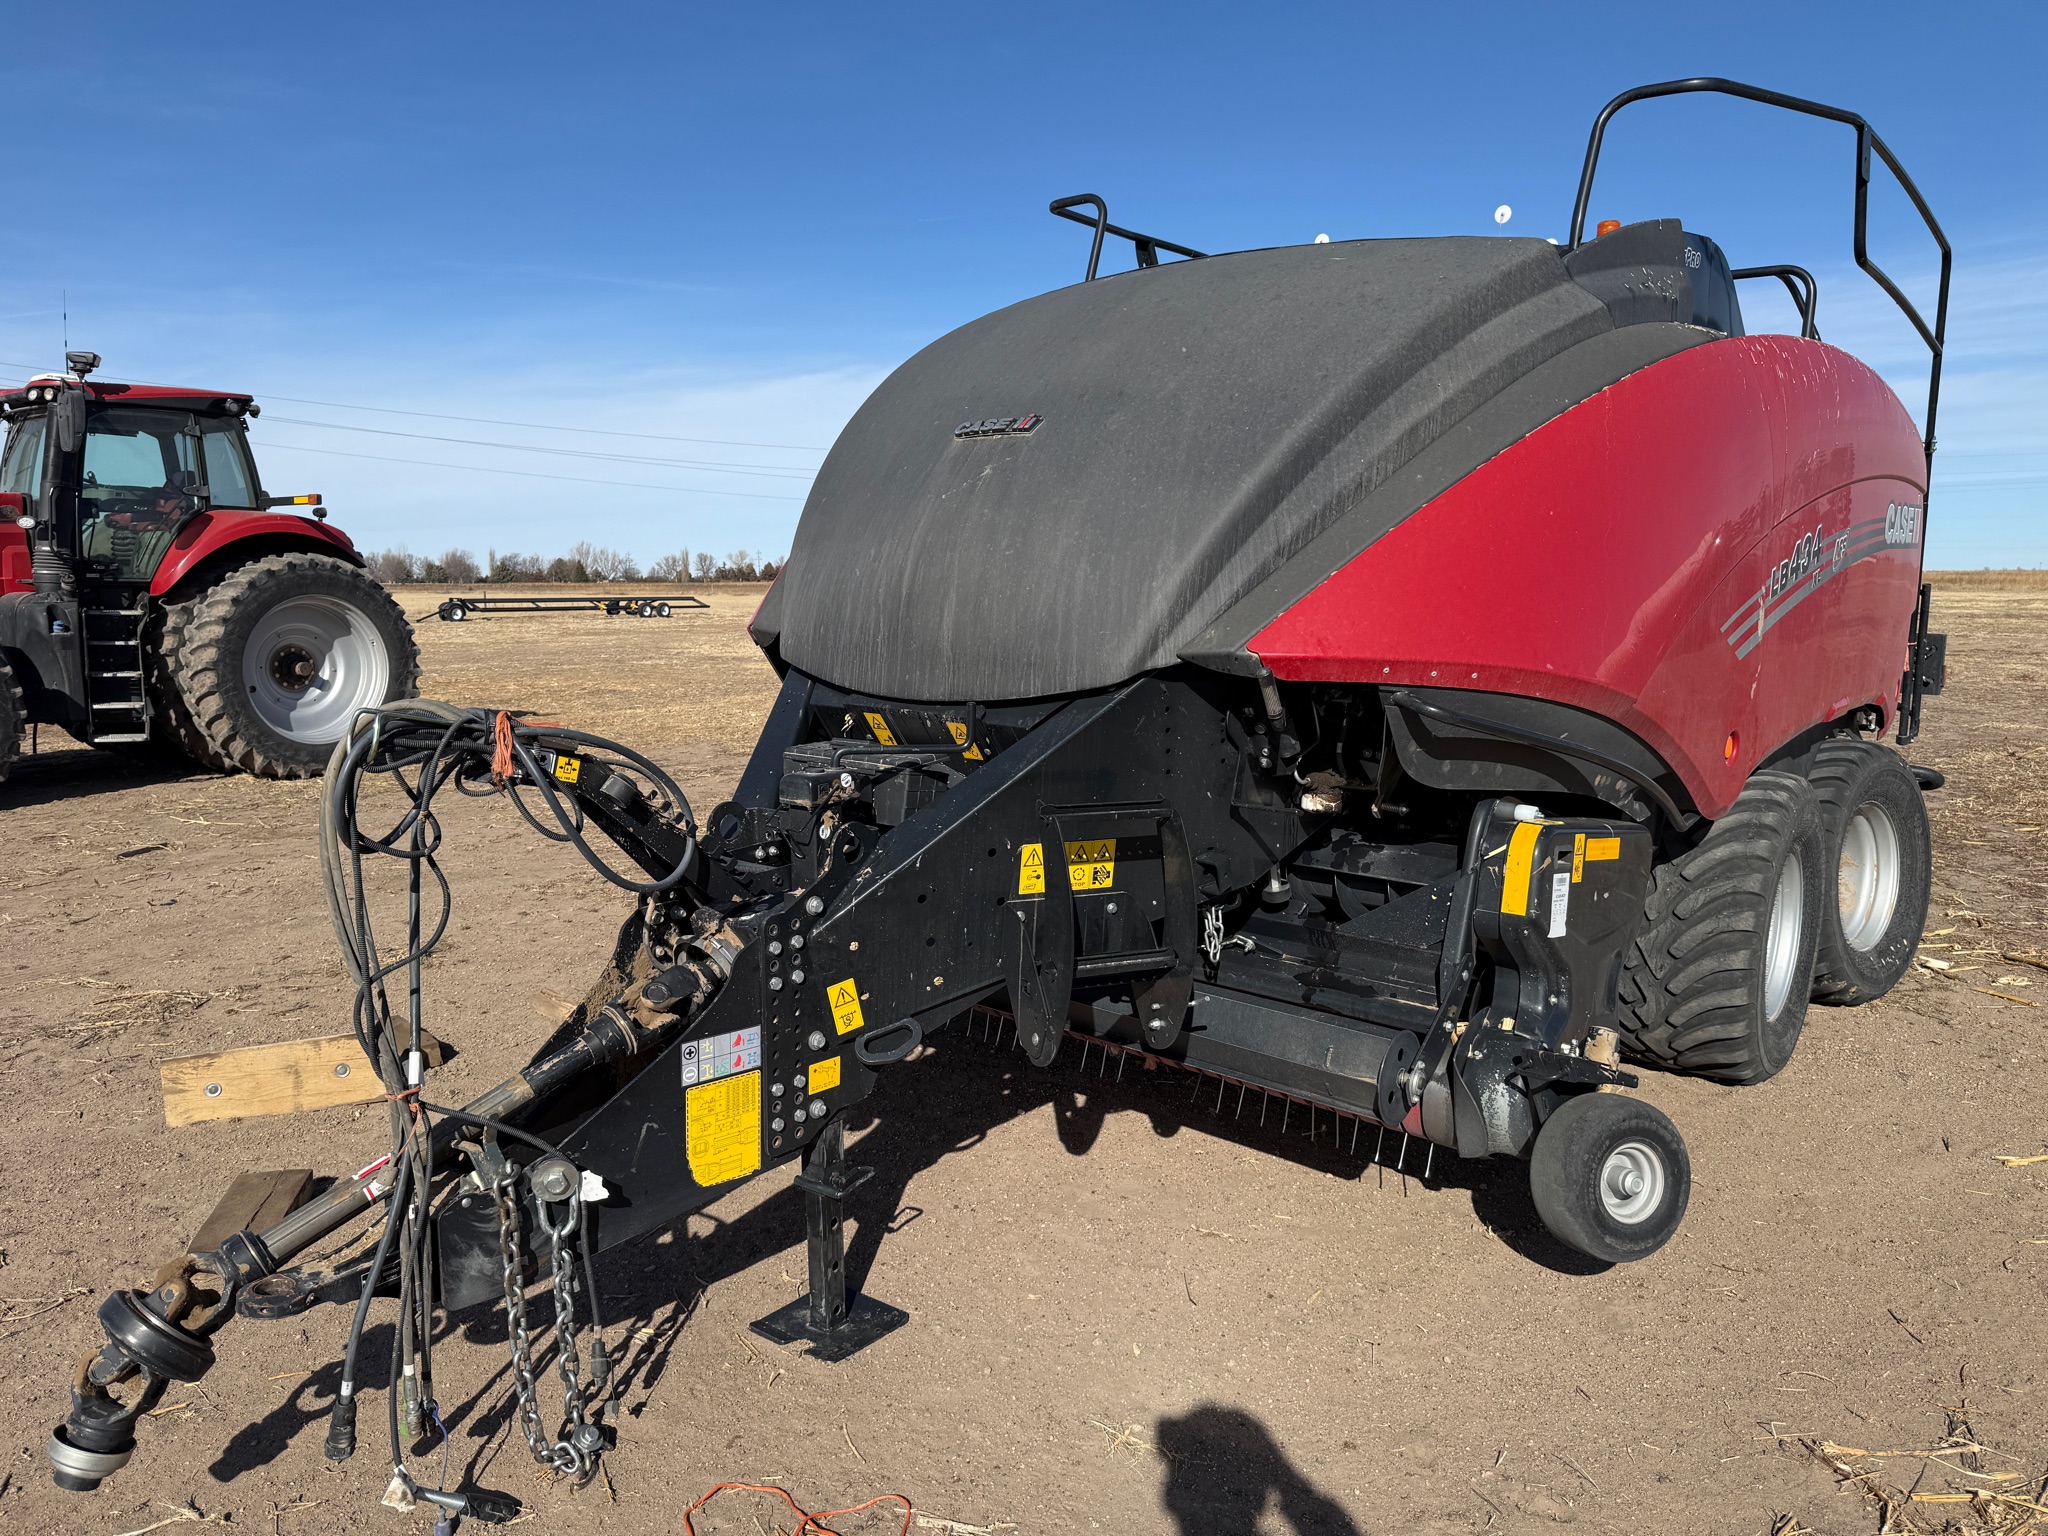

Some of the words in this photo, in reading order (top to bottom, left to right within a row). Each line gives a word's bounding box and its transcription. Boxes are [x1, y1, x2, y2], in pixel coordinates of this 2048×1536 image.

[1684, 246, 1701, 268] PRO
[954, 417, 1015, 436] CASE
[1769, 523, 1823, 600] LB434
